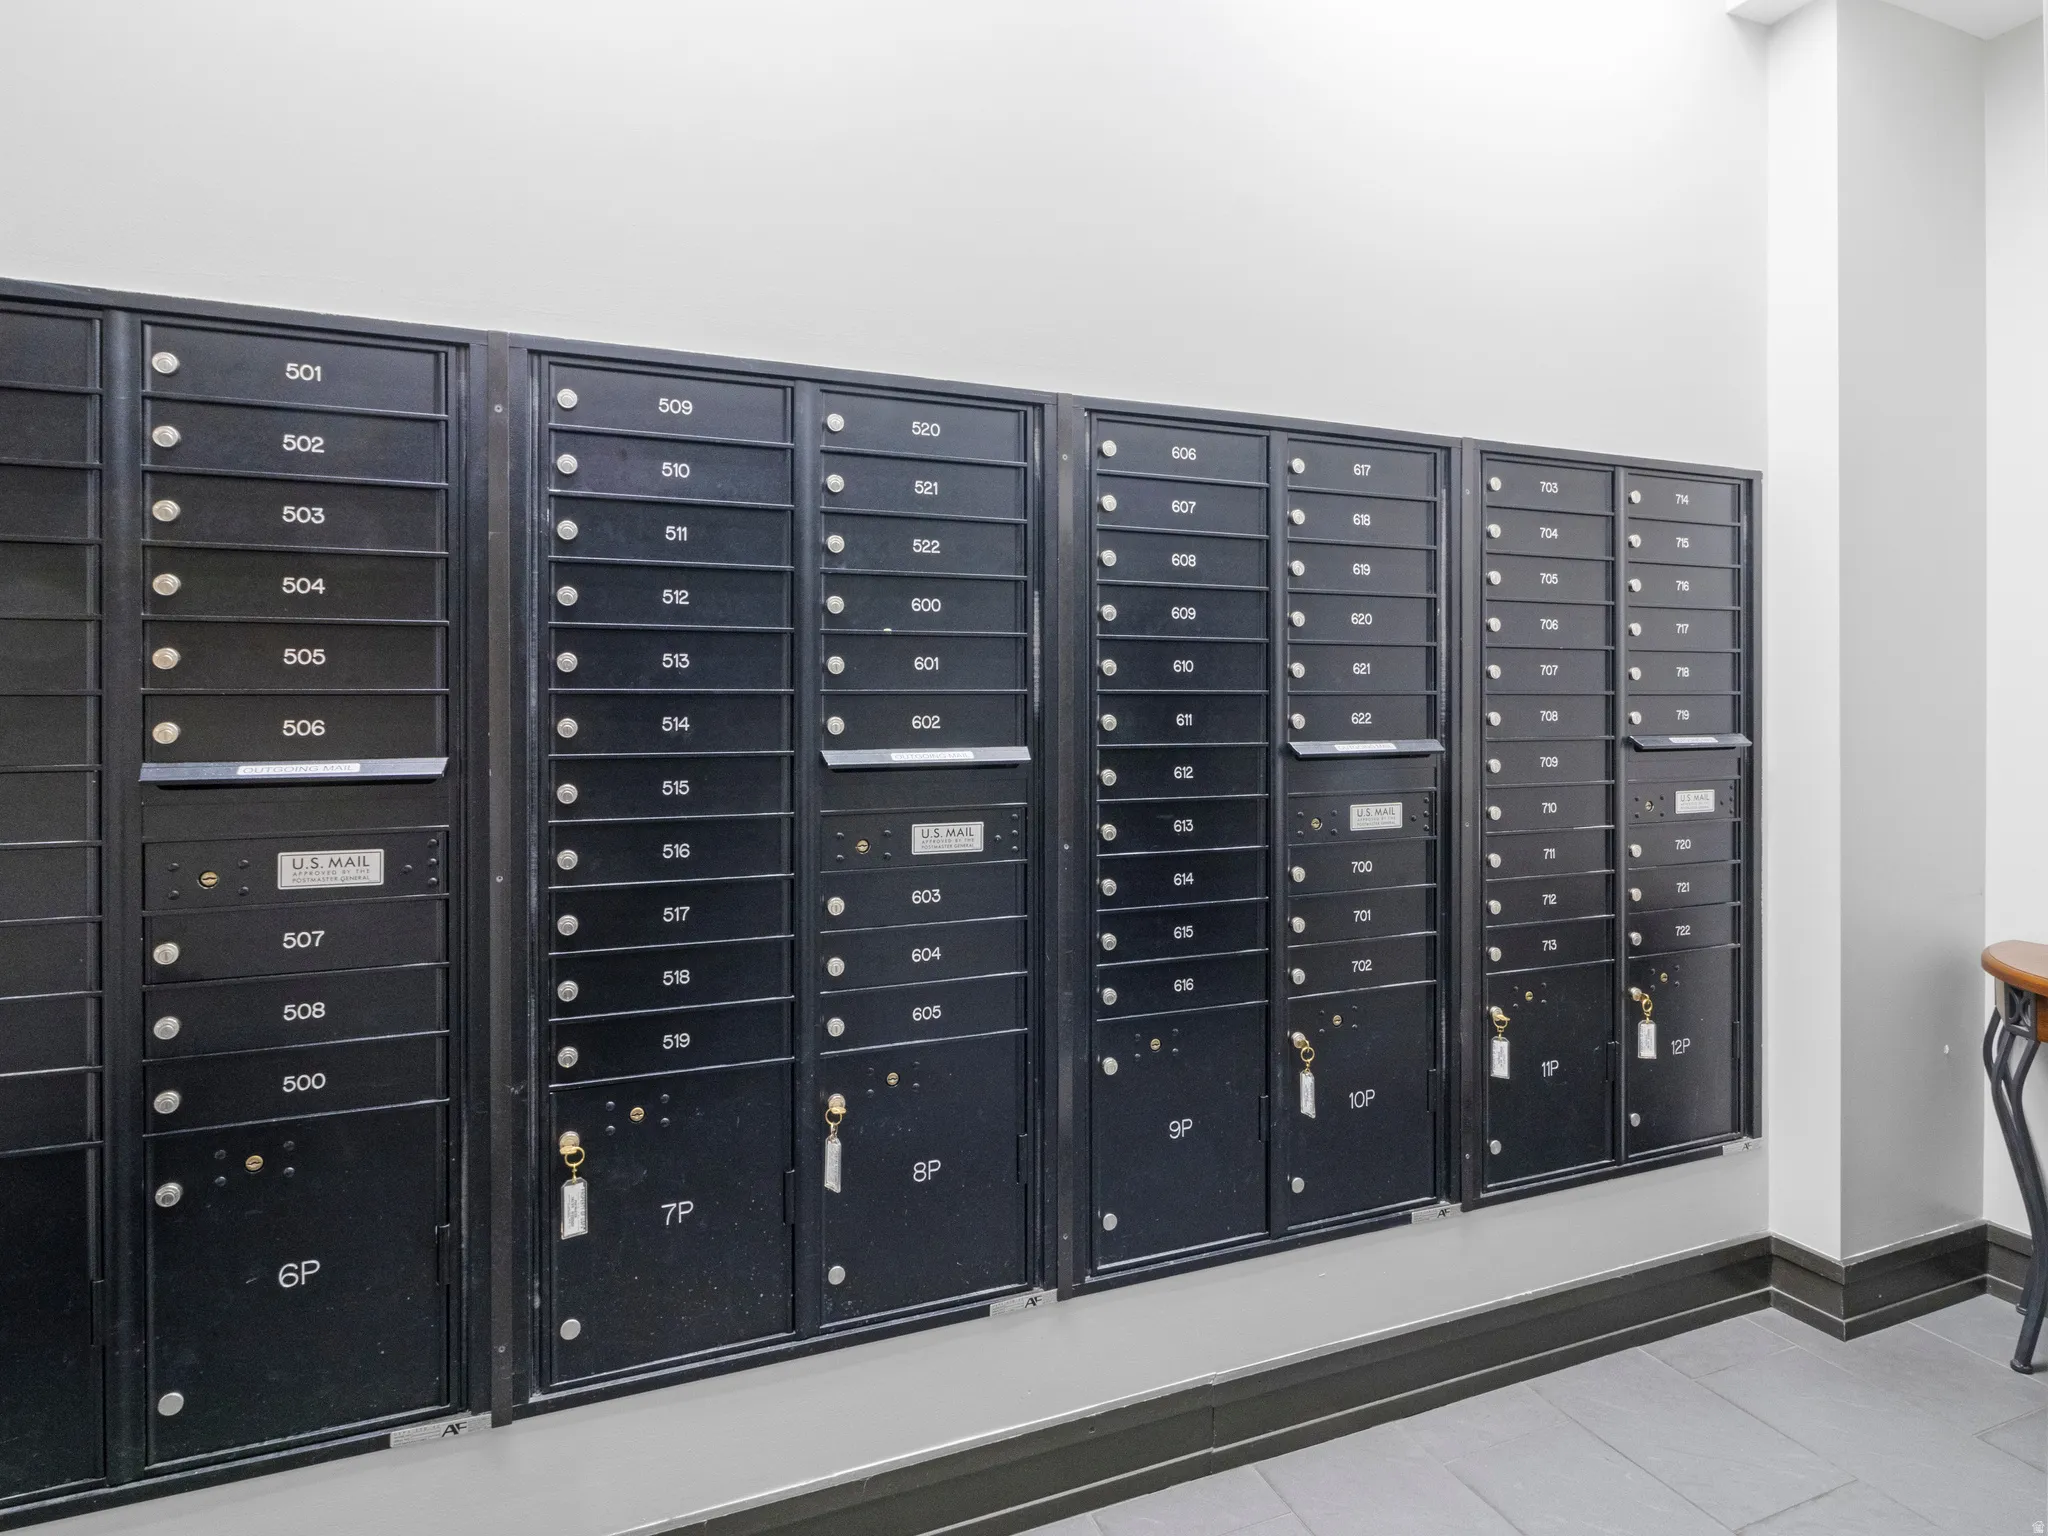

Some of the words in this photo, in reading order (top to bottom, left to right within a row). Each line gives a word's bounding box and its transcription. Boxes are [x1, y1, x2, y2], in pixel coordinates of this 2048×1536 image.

[285, 362, 322, 382] 501
[658, 397, 693, 416] 509
[911, 421, 941, 437] 520
[282, 433, 325, 454] 502
[1171, 446, 1197, 461] 606
[661, 461, 691, 479] 510
[1353, 463, 1372, 477] 617
[914, 480, 938, 496] 521
[1539, 481, 1559, 494] 703
[1171, 499, 1197, 514] 607
[1675, 493, 1690, 506] 714
[282, 505, 326, 525] 503
[1352, 513, 1371, 527] 618
[665, 525, 688, 542] 511
[1539, 526, 1559, 540] 704
[912, 538, 941, 554] 522
[1675, 536, 1690, 549] 715
[1171, 553, 1197, 568] 608
[1352, 562, 1371, 576] 619
[281, 576, 326, 595] 504
[1539, 572, 1559, 585] 705
[1675, 580, 1690, 592] 716
[662, 589, 690, 605] 512
[911, 597, 942, 613] 600
[1171, 606, 1197, 621] 609
[1350, 612, 1373, 626] 620
[1539, 618, 1559, 631] 706
[1675, 623, 1690, 635] 717
[283, 648, 326, 666] 505
[662, 653, 690, 669] 513
[913, 656, 939, 671] 601
[1173, 659, 1194, 673] 610
[1352, 662, 1371, 675] 621
[1539, 664, 1559, 676] 707
[1675, 666, 1690, 678] 718
[911, 714, 941, 730] 602
[1175, 713, 1193, 727] 611
[1351, 712, 1373, 725] 622
[1539, 710, 1559, 722] 708
[1675, 709, 1690, 721] 719
[282, 719, 326, 737] 506
[661, 716, 691, 732] 514
[242, 765, 319, 774] OUTGOING
[322, 764, 354, 772] MAIL
[1539, 756, 1559, 768] 709
[1173, 765, 1194, 780] 612
[661, 779, 690, 796] 515
[1693, 793, 1710, 801] MAIL
[1356, 808, 1373, 817] U.S.
[1375, 807, 1396, 816] MAIL
[1541, 801, 1558, 814] 710
[921, 828, 943, 839] U.S.
[945, 827, 974, 838] MAIL
[1173, 819, 1194, 833] 613
[662, 842, 691, 859] 516
[1674, 838, 1692, 851] 720
[1543, 847, 1556, 860] 711
[292, 857, 324, 870] U.S.
[328, 855, 370, 868] MAIL
[1351, 860, 1373, 874] 700
[292, 869, 337, 877] APPROVED
[292, 876, 338, 884] POSTMASTER
[340, 875, 370, 883] GENERAL
[1173, 872, 1195, 886] 614
[1676, 881, 1690, 893] 721
[911, 888, 942, 905] 603
[1541, 893, 1558, 906] 712
[662, 906, 691, 923] 517
[1353, 909, 1371, 923] 701
[1173, 925, 1194, 940] 615
[1674, 924, 1692, 937] 722
[282, 930, 325, 949] 507
[1541, 939, 1558, 952] 713
[911, 946, 942, 963] 604
[1351, 958, 1373, 973] 702
[662, 969, 691, 986] 518
[1173, 977, 1194, 993] 616
[283, 1001, 326, 1022] 508
[912, 1004, 942, 1022] 605
[662, 1032, 691, 1050] 519
[1670, 1037, 1691, 1055] 12P
[1541, 1059, 1560, 1078] 11P
[282, 1072, 327, 1093] 500
[1348, 1088, 1376, 1110] 10P
[1168, 1118, 1193, 1140] 9P
[912, 1159, 942, 1183] 8P
[660, 1200, 694, 1226] 7P
[278, 1259, 321, 1289] 6P
